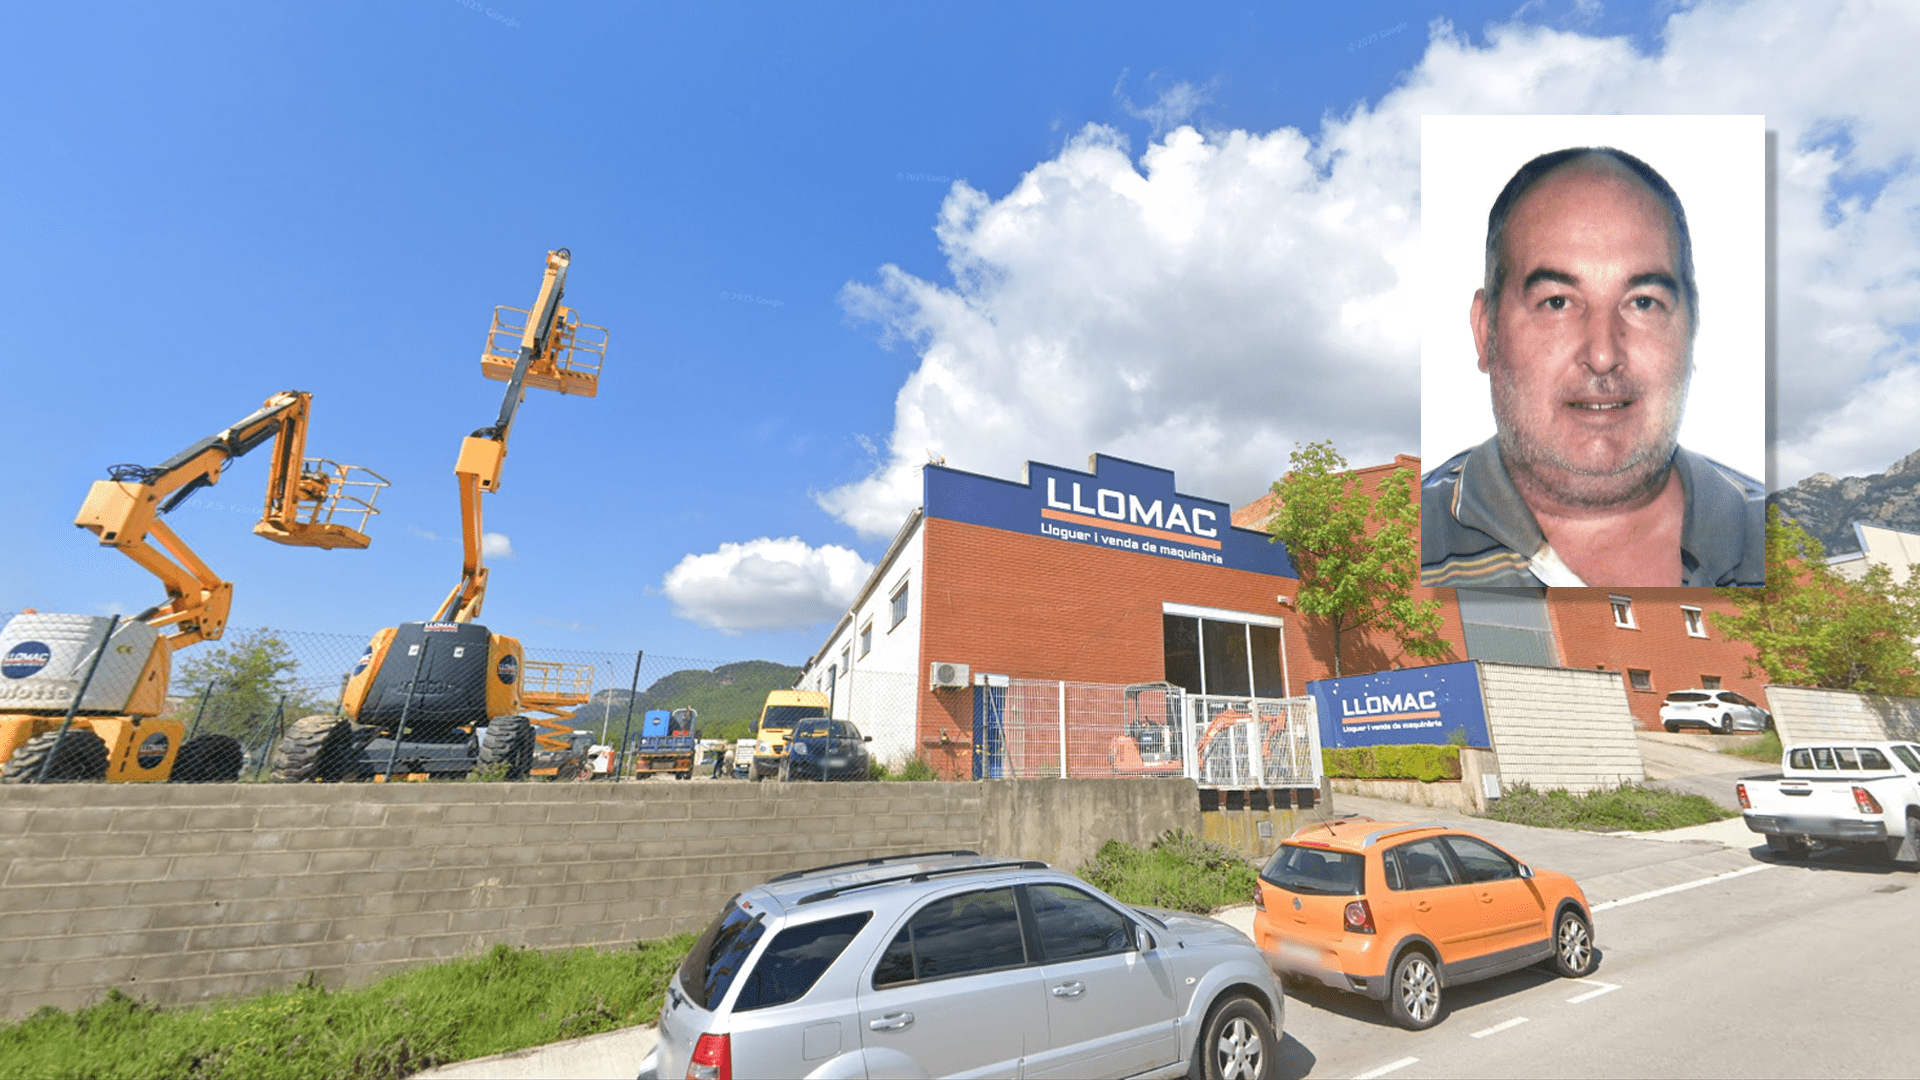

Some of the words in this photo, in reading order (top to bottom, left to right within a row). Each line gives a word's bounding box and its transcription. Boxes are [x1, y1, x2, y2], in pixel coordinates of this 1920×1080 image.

[1047, 477, 1218, 537] LLOMAC
[1041, 522, 1091, 541] Lloguer
[1094, 532, 1099, 543] i
[1101, 535, 1139, 550] venda
[1142, 541, 1157, 553] de
[1160, 545, 1223, 564] maquinària
[1342, 691, 1437, 716] LLOMAC
